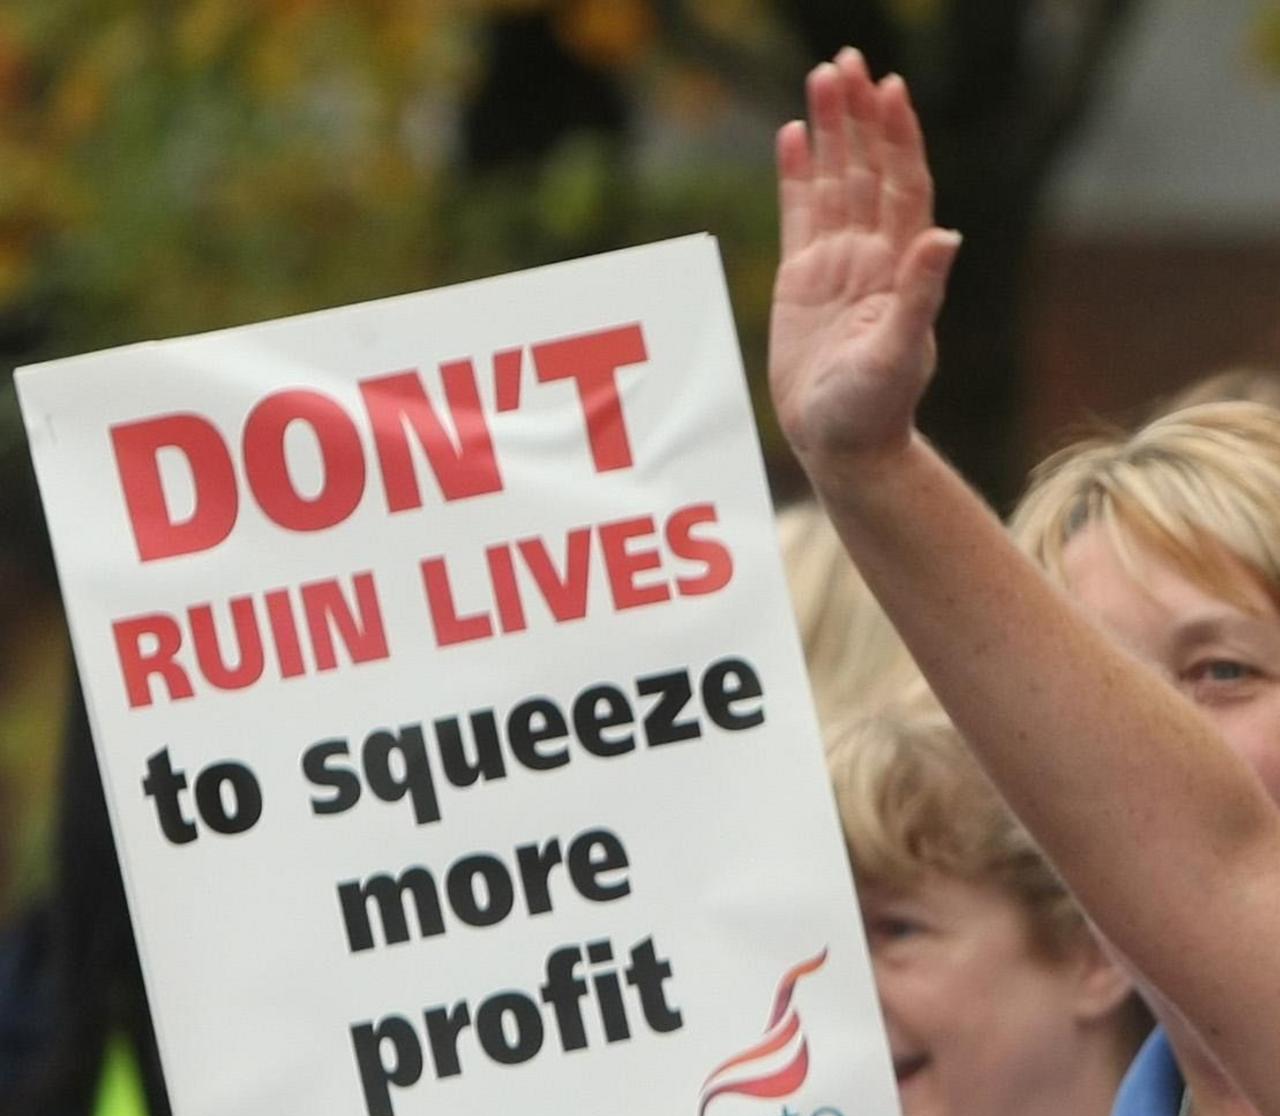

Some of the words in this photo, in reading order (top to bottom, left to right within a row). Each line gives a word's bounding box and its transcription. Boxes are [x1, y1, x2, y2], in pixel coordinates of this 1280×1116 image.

[109, 321, 649, 563] DON'T
[111, 570, 390, 711] RUIN
[419, 502, 735, 656] LIVES
[141, 747, 264, 846] to
[301, 658, 766, 826] squeeze
[336, 827, 632, 955] more
